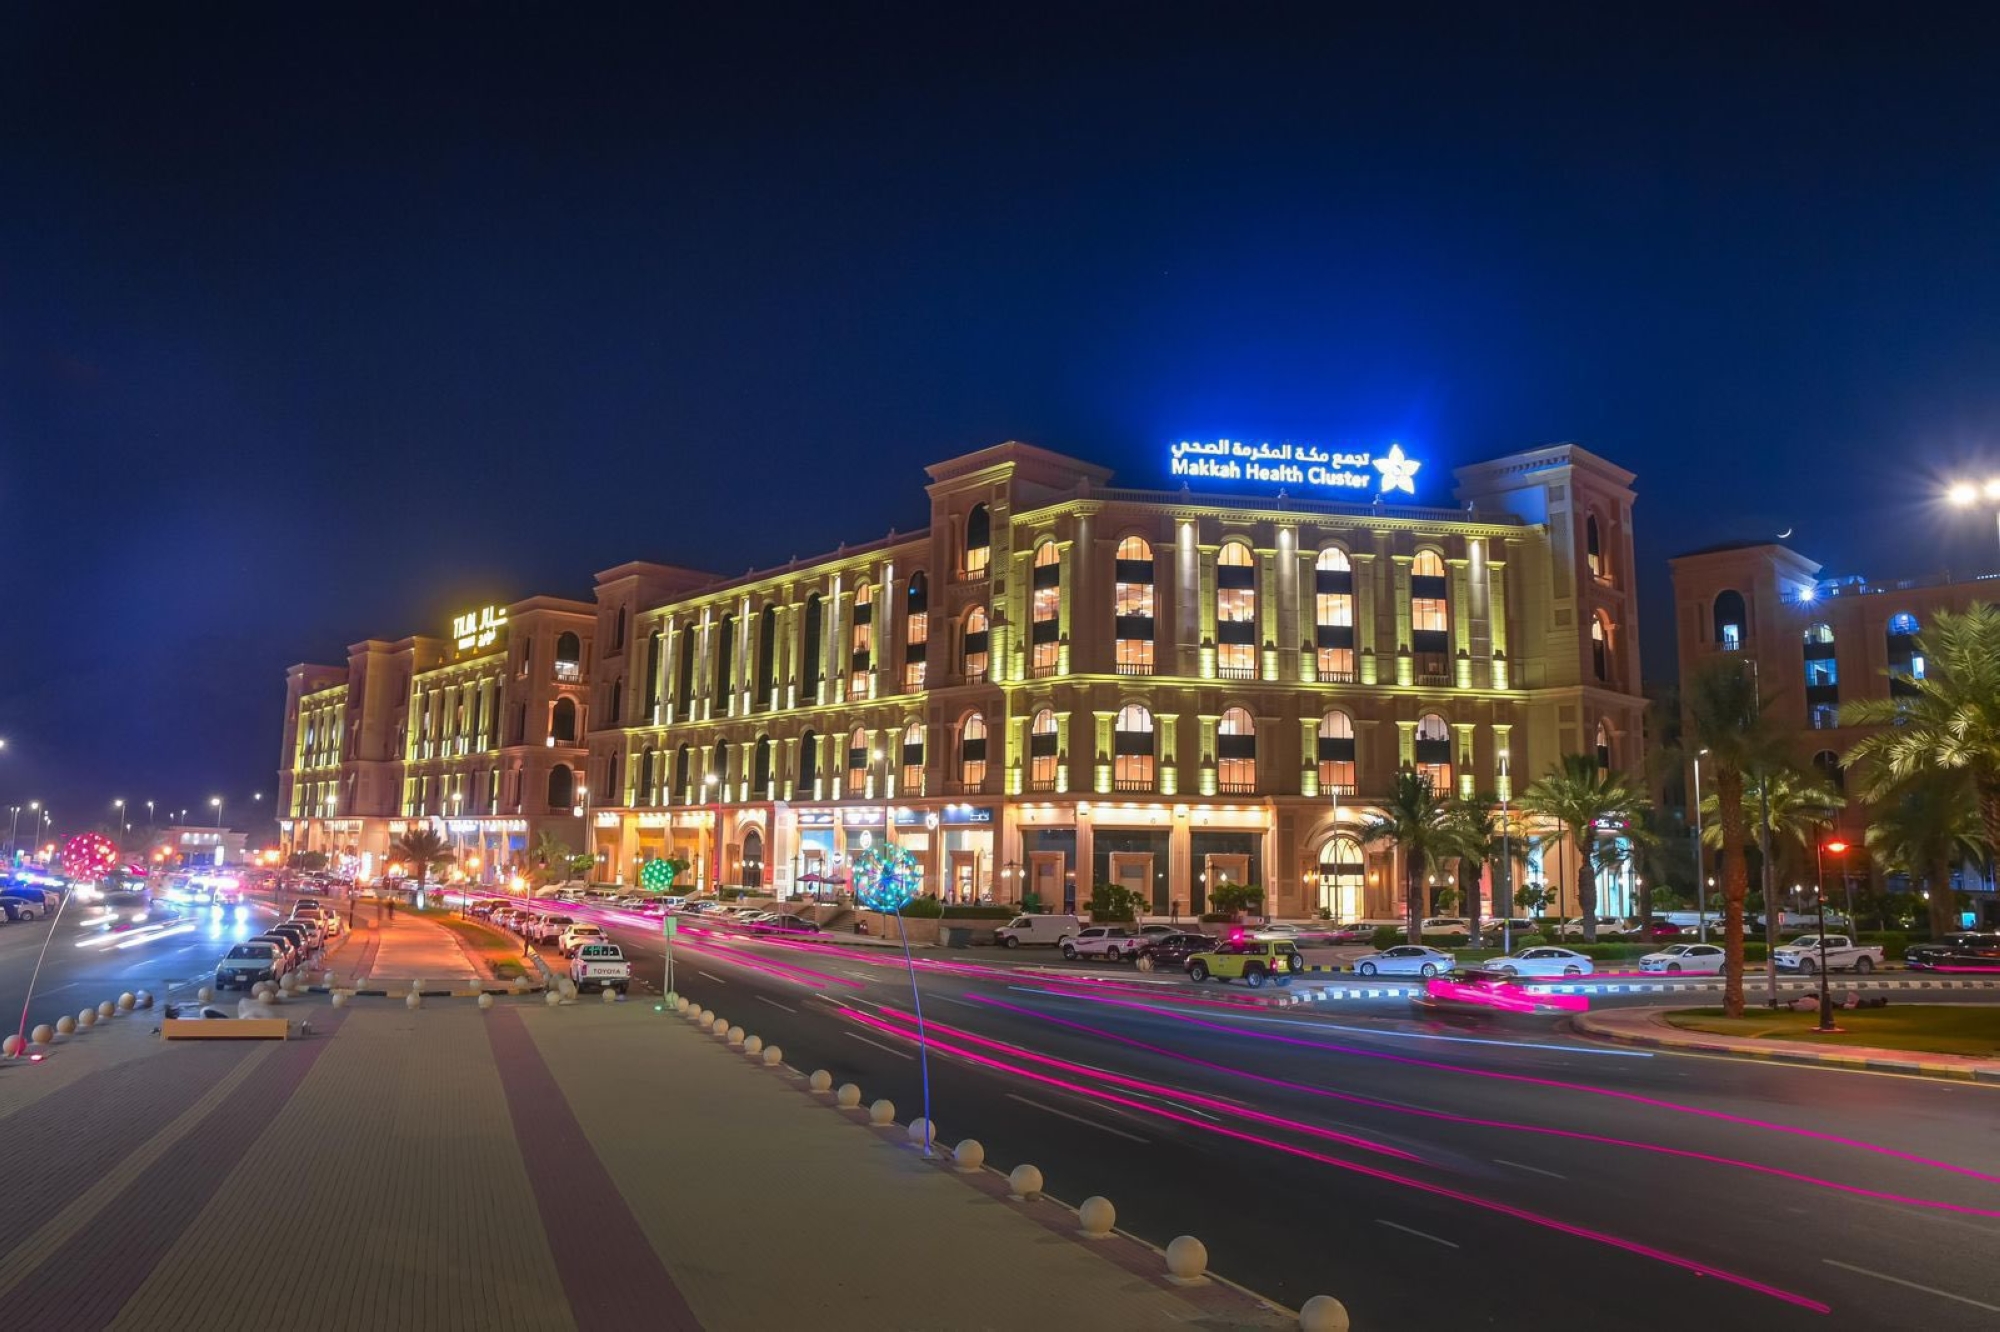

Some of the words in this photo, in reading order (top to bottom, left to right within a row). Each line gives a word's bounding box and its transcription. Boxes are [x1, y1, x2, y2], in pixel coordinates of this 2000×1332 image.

[1171, 439, 1229, 457] الصحي
[1232, 442, 1291, 460] المكرمة
[1295, 447, 1329, 462] مكة
[1332, 452, 1371, 469] تجمع
[1171, 458, 1240, 478] Makkah
[1246, 463, 1303, 483] Health
[1308, 467, 1370, 487] Cluster
